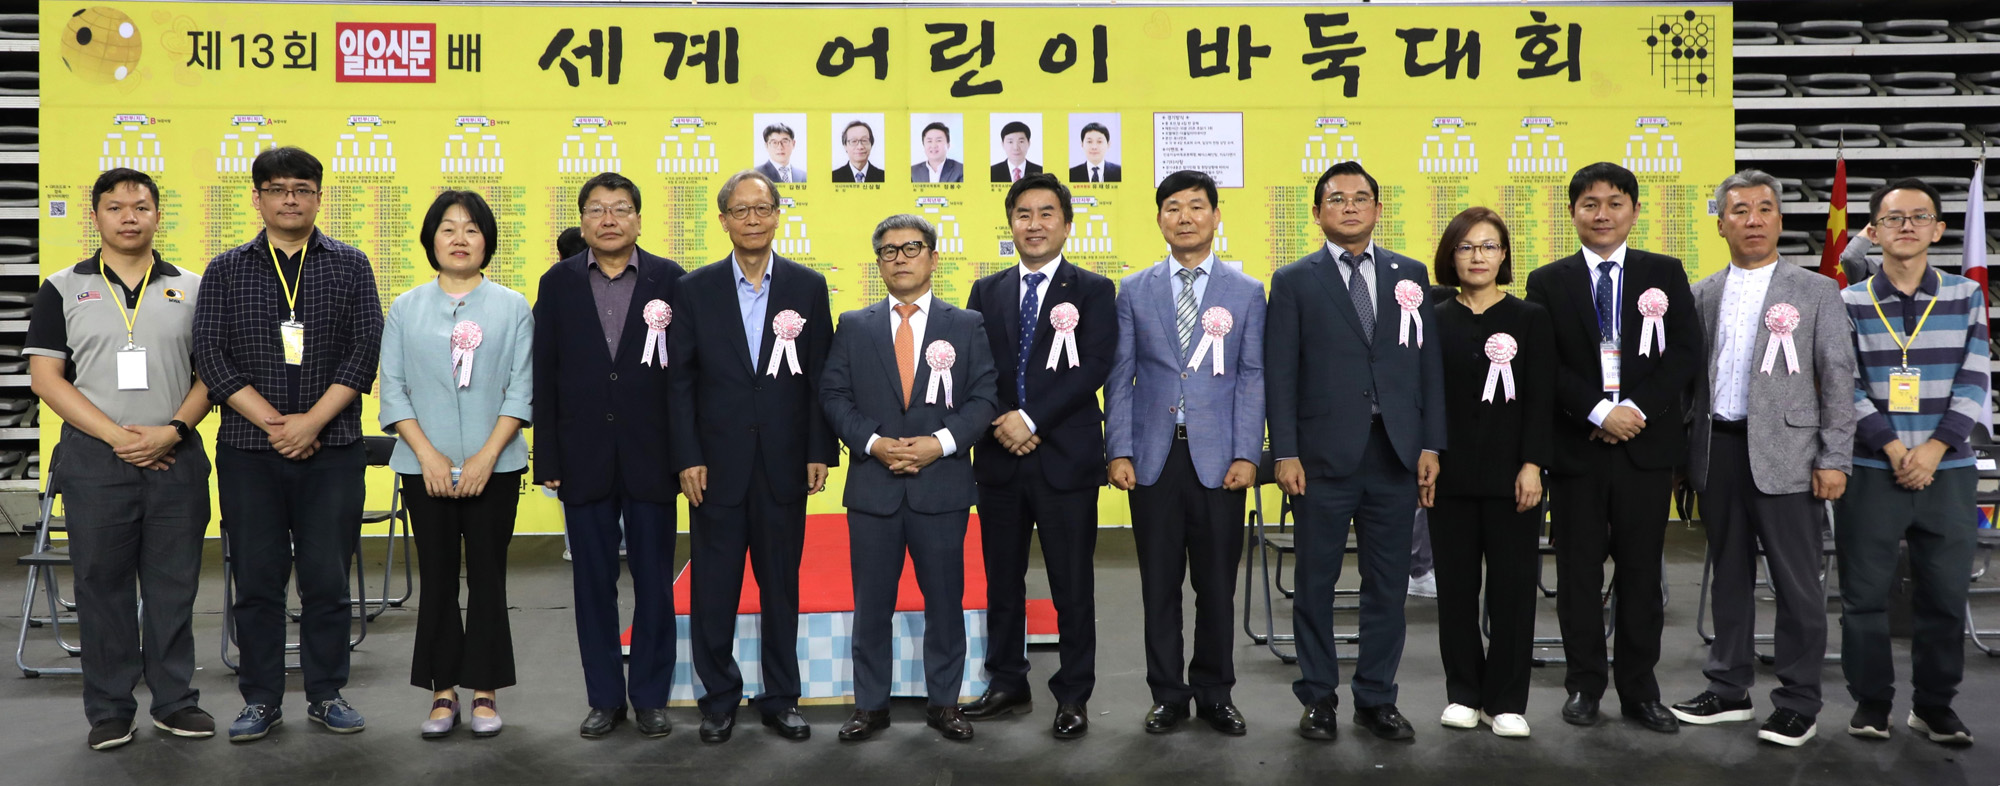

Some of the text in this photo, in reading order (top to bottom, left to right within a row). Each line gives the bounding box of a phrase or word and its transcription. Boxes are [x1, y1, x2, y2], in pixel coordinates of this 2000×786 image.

[338, 28, 432, 77] 일요신문
[448, 33, 481, 73] 배
[815, 19, 1108, 98] 어린이
